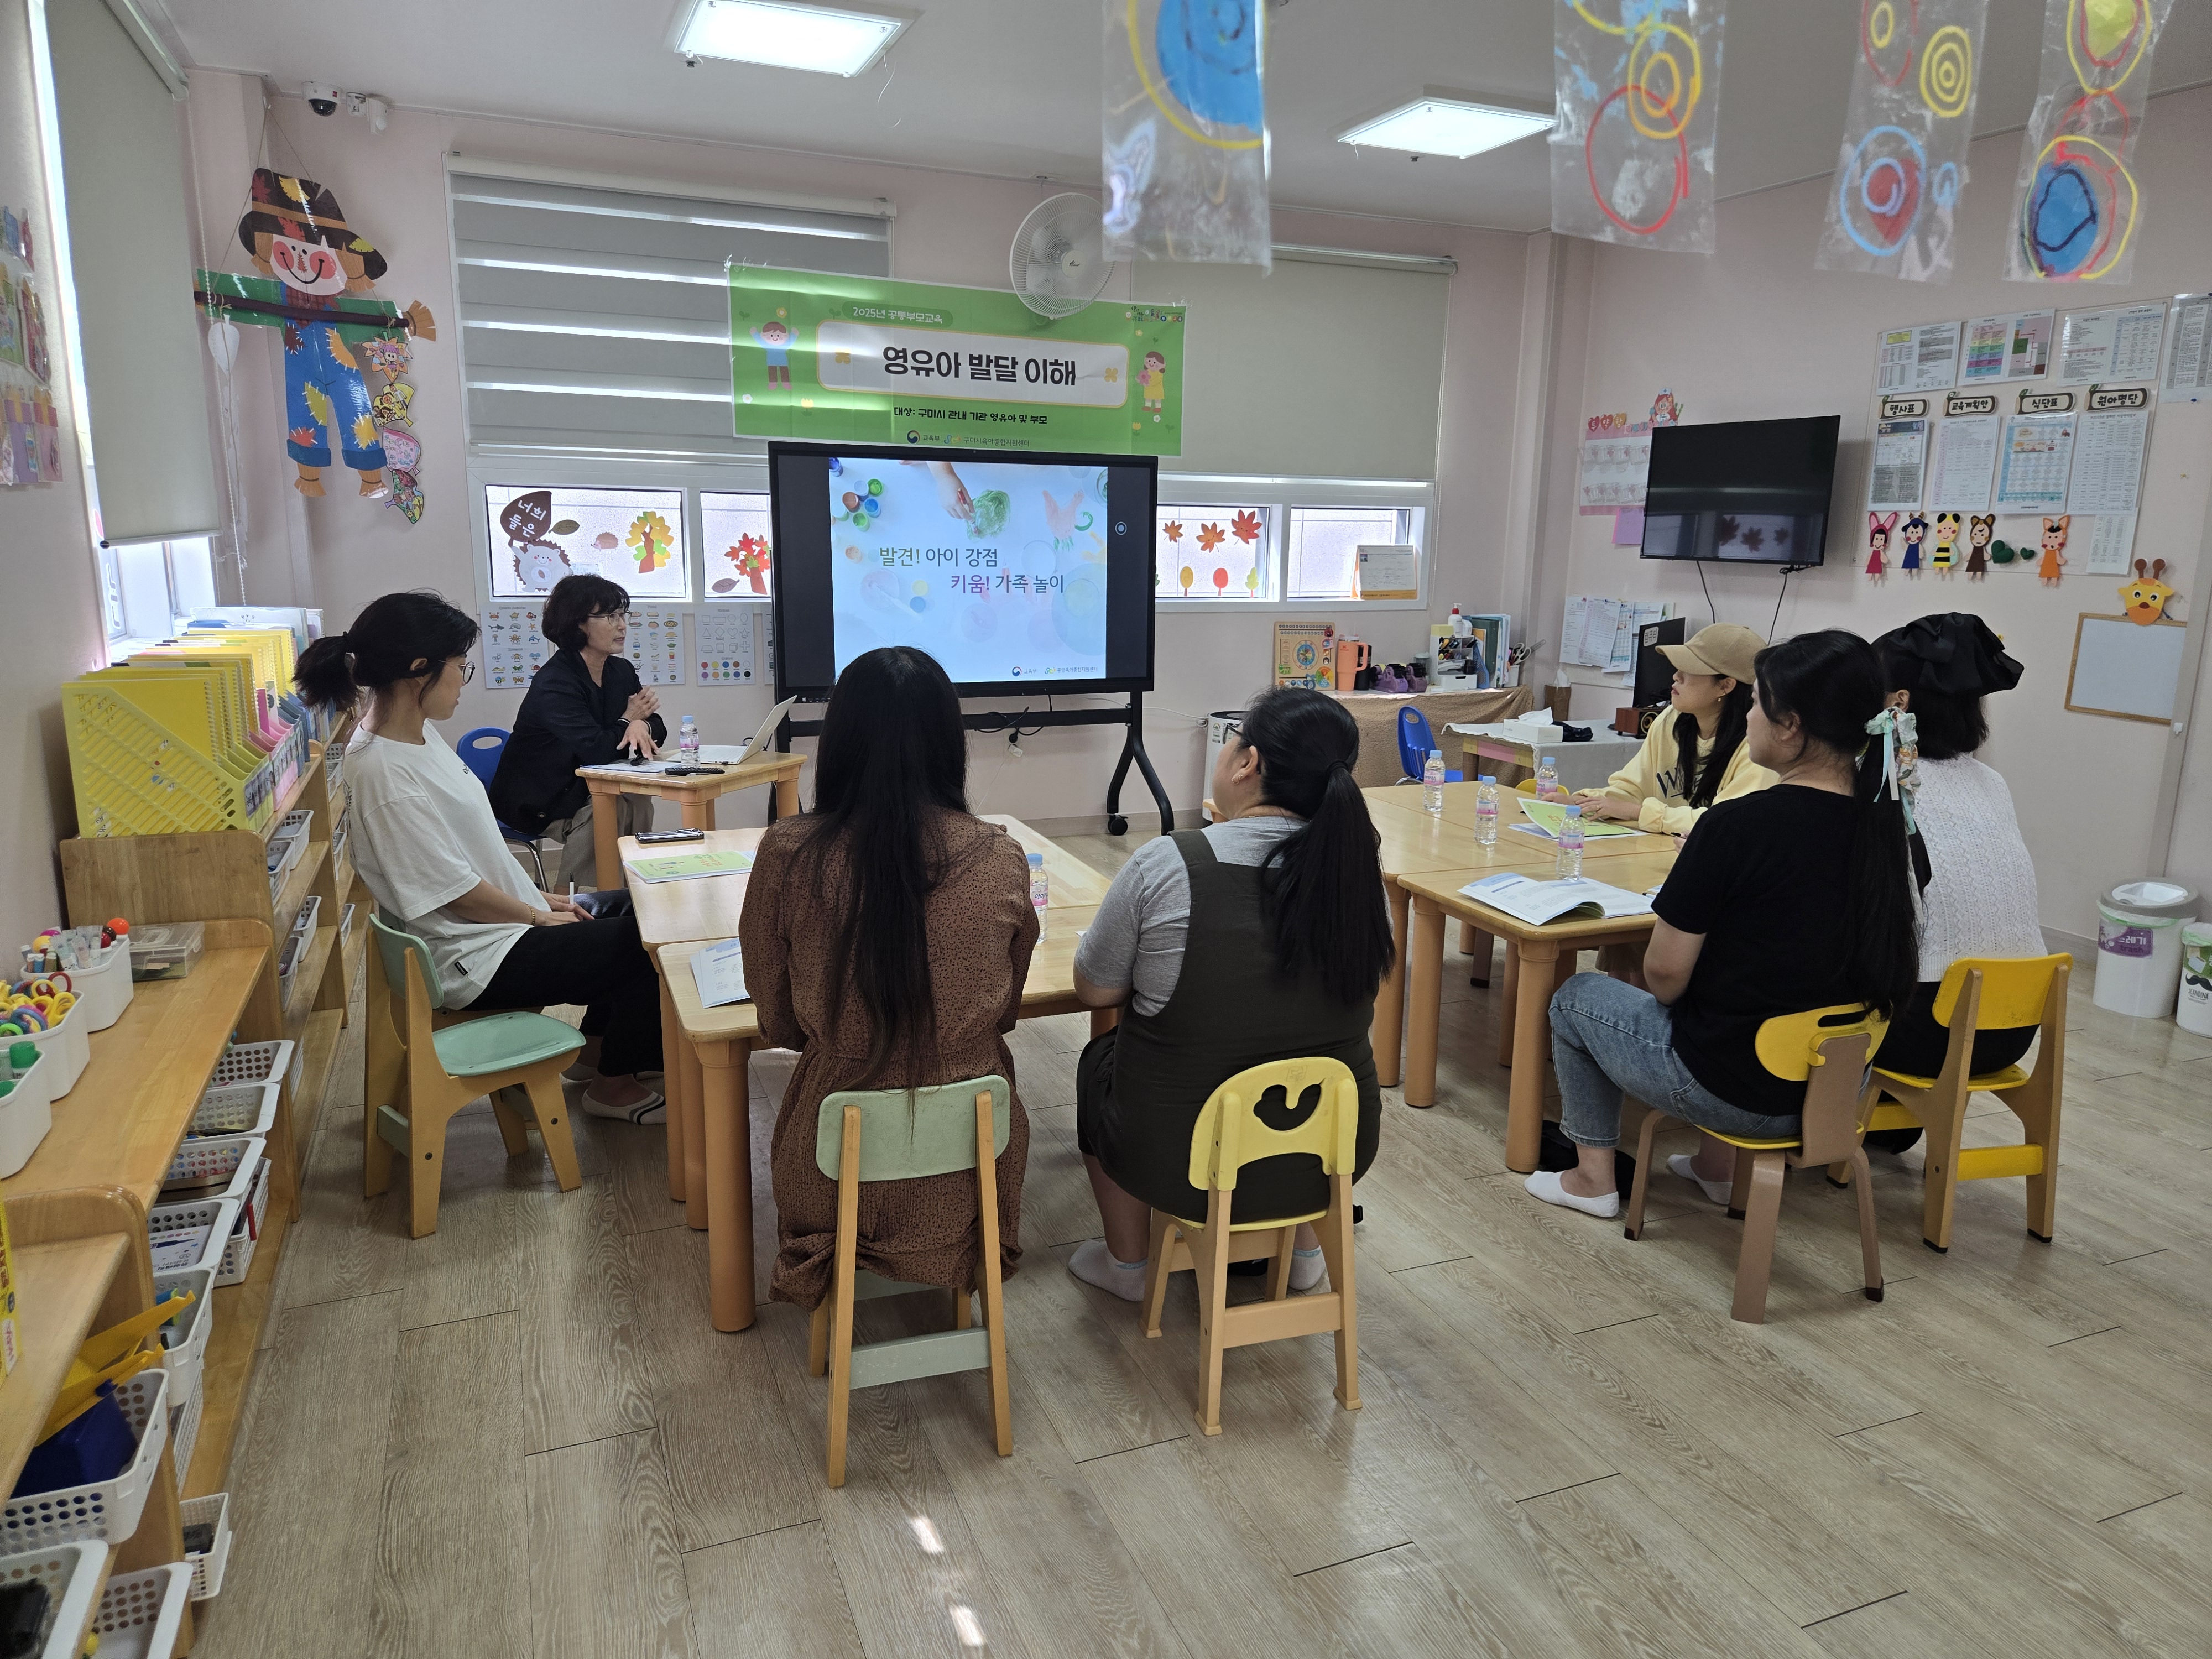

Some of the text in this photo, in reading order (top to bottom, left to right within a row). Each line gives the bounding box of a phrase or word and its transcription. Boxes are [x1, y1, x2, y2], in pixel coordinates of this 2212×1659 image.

[853, 307, 942, 324] 2025년 공통부모교육
[883, 346, 1076, 387] 영유아 발달 이해
[1952, 400, 1989, 411] 교육계획안
[2032, 398, 2058, 409] 식단표
[2097, 393, 2138, 406] 원아명단
[894, 407, 1047, 424] 대상: 구미시 관내 기관 영유아 및 부모
[1890, 404, 1914, 415] 행사표
[964, 437, 1030, 447] 구미시육아종합지원센터
[518, 499, 547, 521] 너희
[509, 514, 535, 538] 들은
[879, 547, 998, 567] 발견! 아이 강점
[951, 574, 1064, 594] 키움! 가족 놀이
